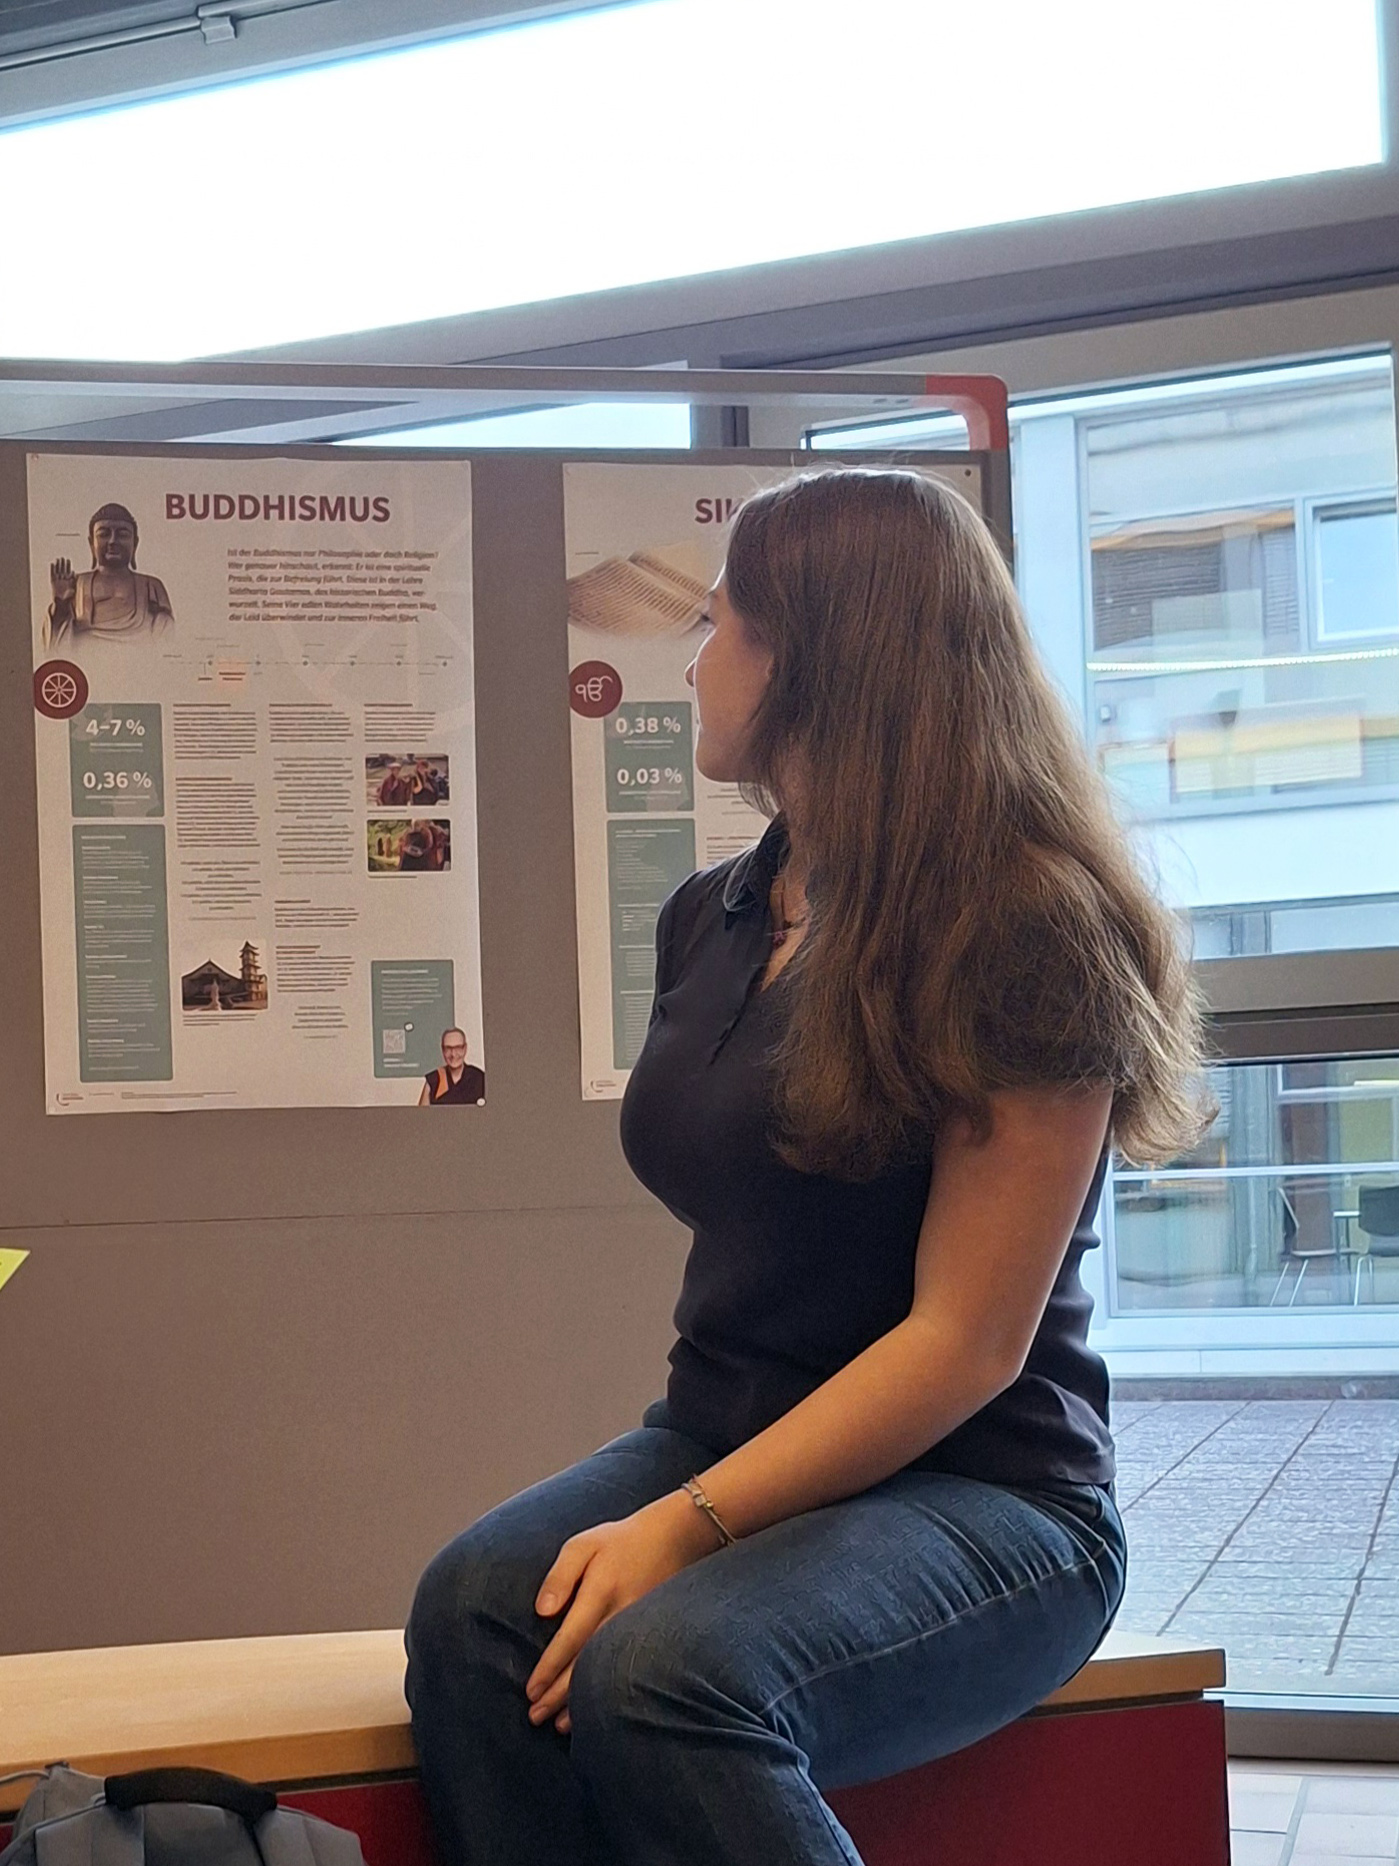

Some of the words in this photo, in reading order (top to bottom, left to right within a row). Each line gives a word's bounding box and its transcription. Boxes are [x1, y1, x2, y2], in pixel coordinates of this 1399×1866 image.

[165, 492, 391, 523] BUDDHISMUS
[125, 719, 146, 736] %
[615, 717, 659, 736] 0,38
[663, 716, 681, 733] %
[83, 771, 129, 791] 0,36
[132, 771, 152, 788] %
[617, 768, 660, 787] 0,03
[664, 767, 682, 784] %
